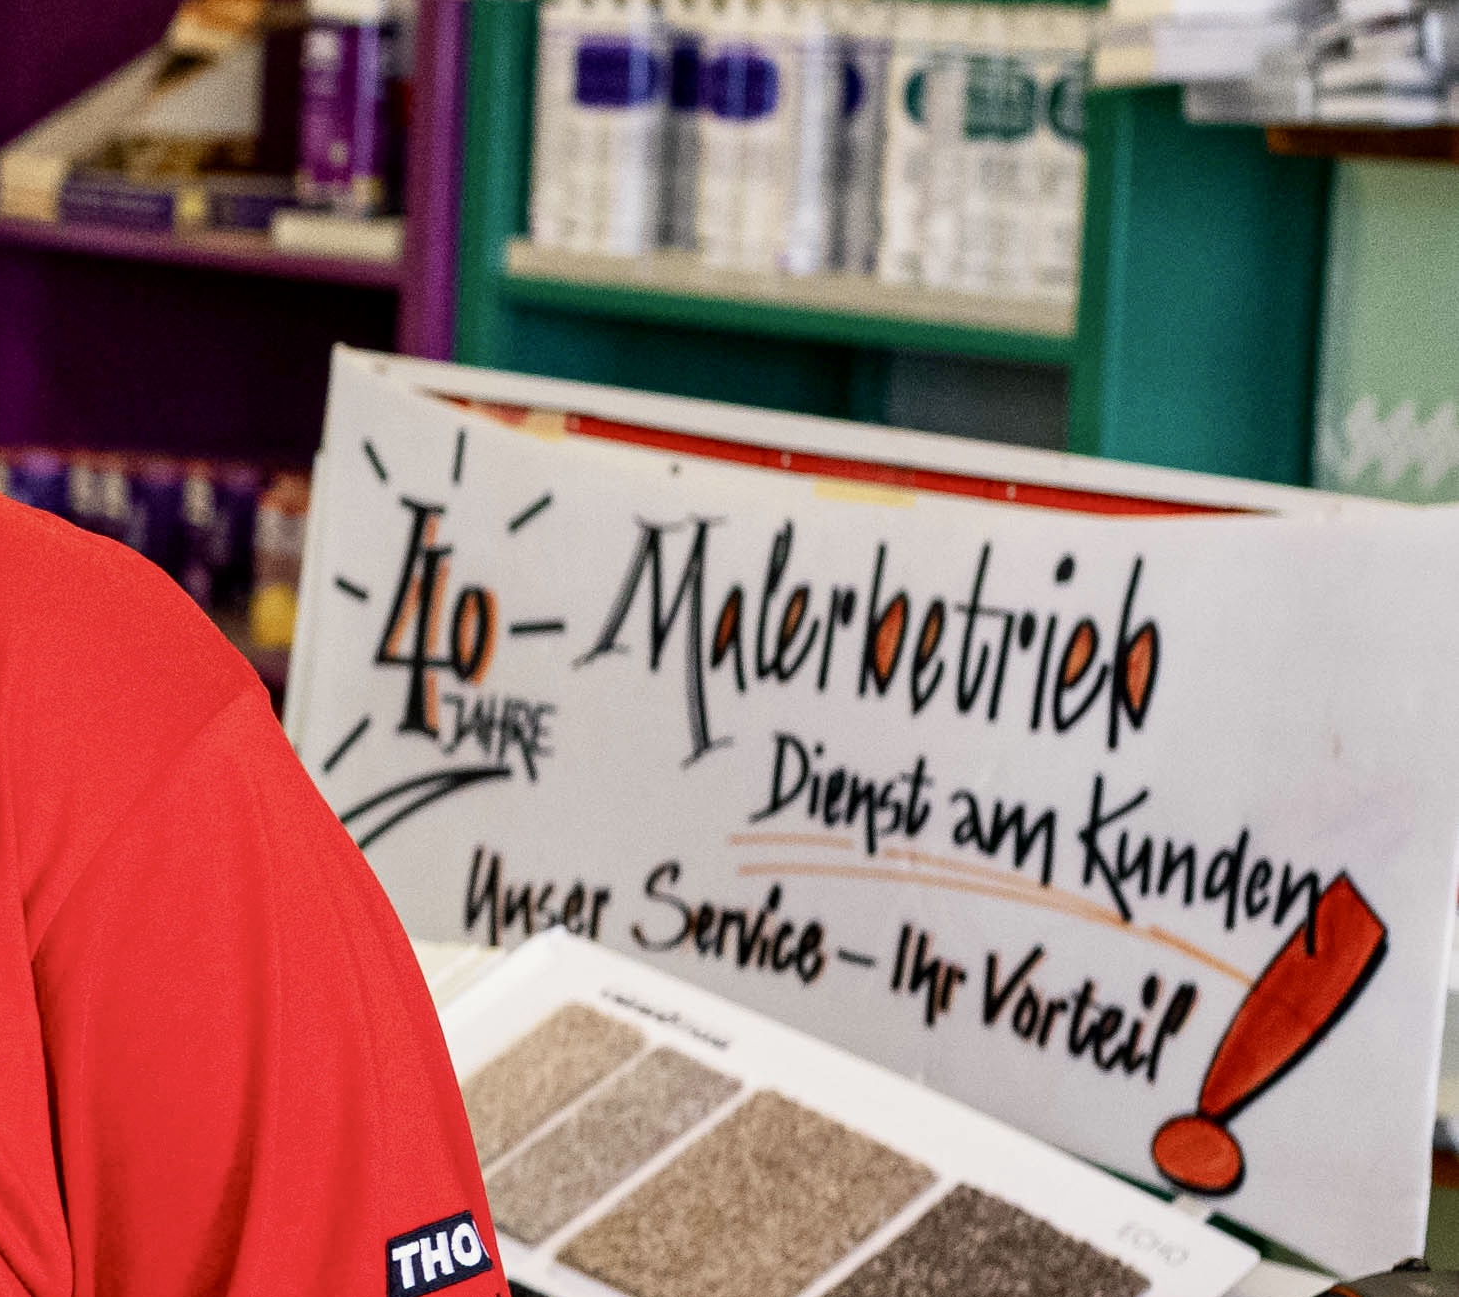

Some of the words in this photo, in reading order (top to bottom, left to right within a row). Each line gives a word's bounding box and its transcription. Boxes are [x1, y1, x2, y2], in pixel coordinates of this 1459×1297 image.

[373, 495, 500, 739] 40
[571, 515, 1161, 768] Malerbetrieb
[443, 693, 557, 783] JAHRE
[463, 845, 613, 947] Unser
[630, 860, 826, 985] Service
[890, 923, 968, 1029] Ihr
[748, 732, 931, 857] Dienst
[951, 790, 1057, 888] am
[1078, 773, 1320, 957] Kunden
[391, 1220, 491, 1290] THO
